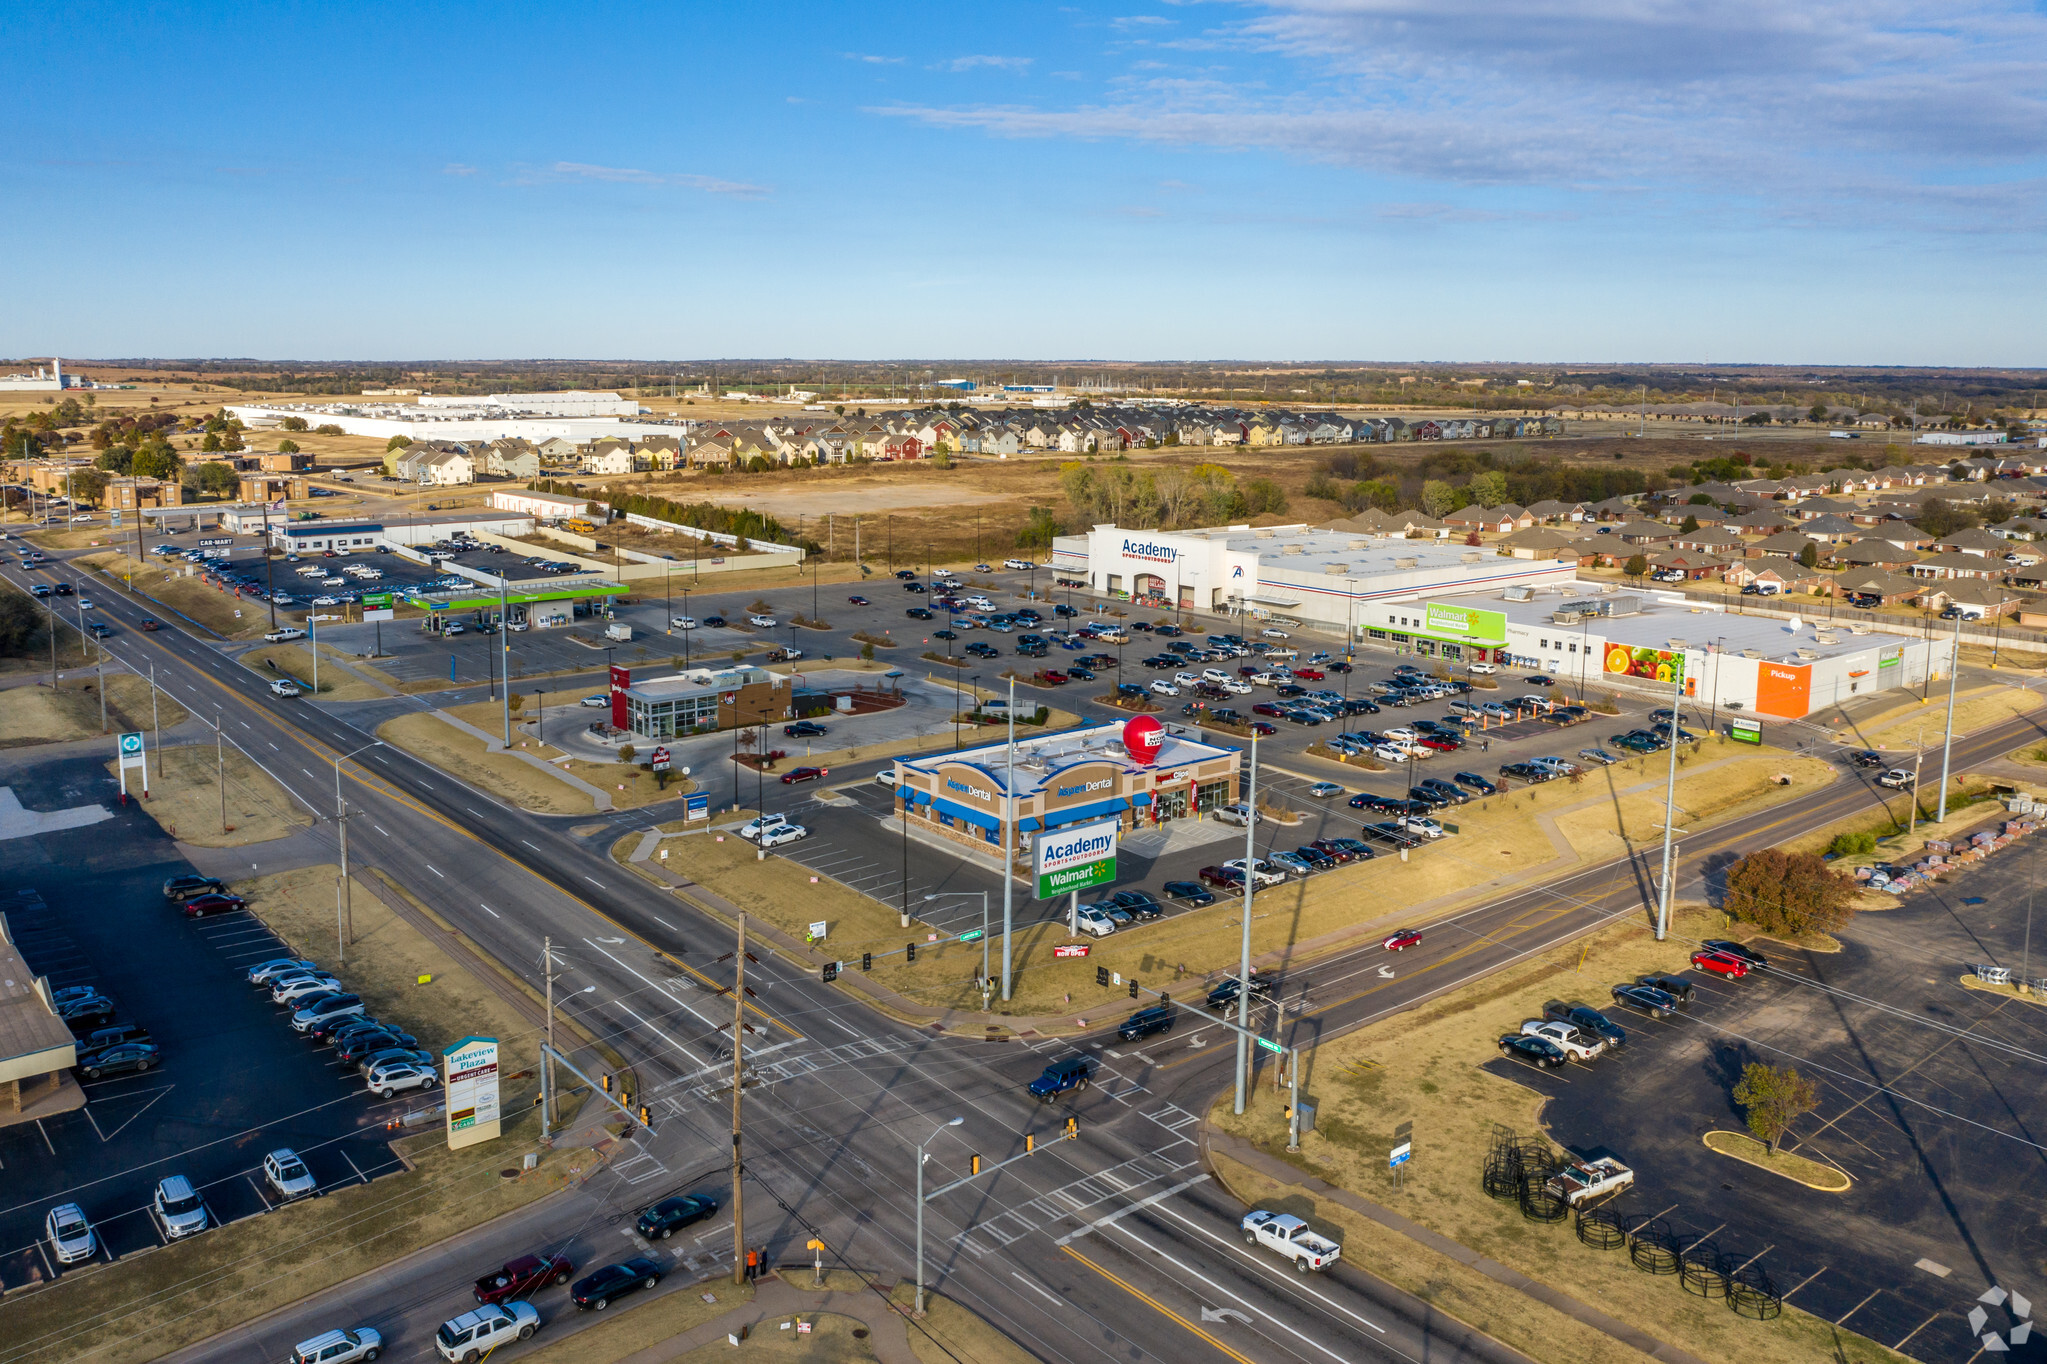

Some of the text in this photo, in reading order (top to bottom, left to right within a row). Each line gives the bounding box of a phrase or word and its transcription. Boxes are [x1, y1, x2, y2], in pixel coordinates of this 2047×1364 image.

[1122, 539, 1177, 562] Academy
[1430, 607, 1467, 622] Walmart
[1507, 628, 1529, 637] Pharmacy
[1771, 669, 1796, 681] Pickup
[1044, 834, 1112, 861] Academy
[1050, 865, 1093, 887] Walmart
[1052, 880, 1093, 895] Neighborhood Market
[451, 1047, 495, 1064] Lakeview
[460, 1058, 486, 1070] Plaza
[456, 1070, 477, 1081] URGENT
[477, 1067, 490, 1076] CARE
